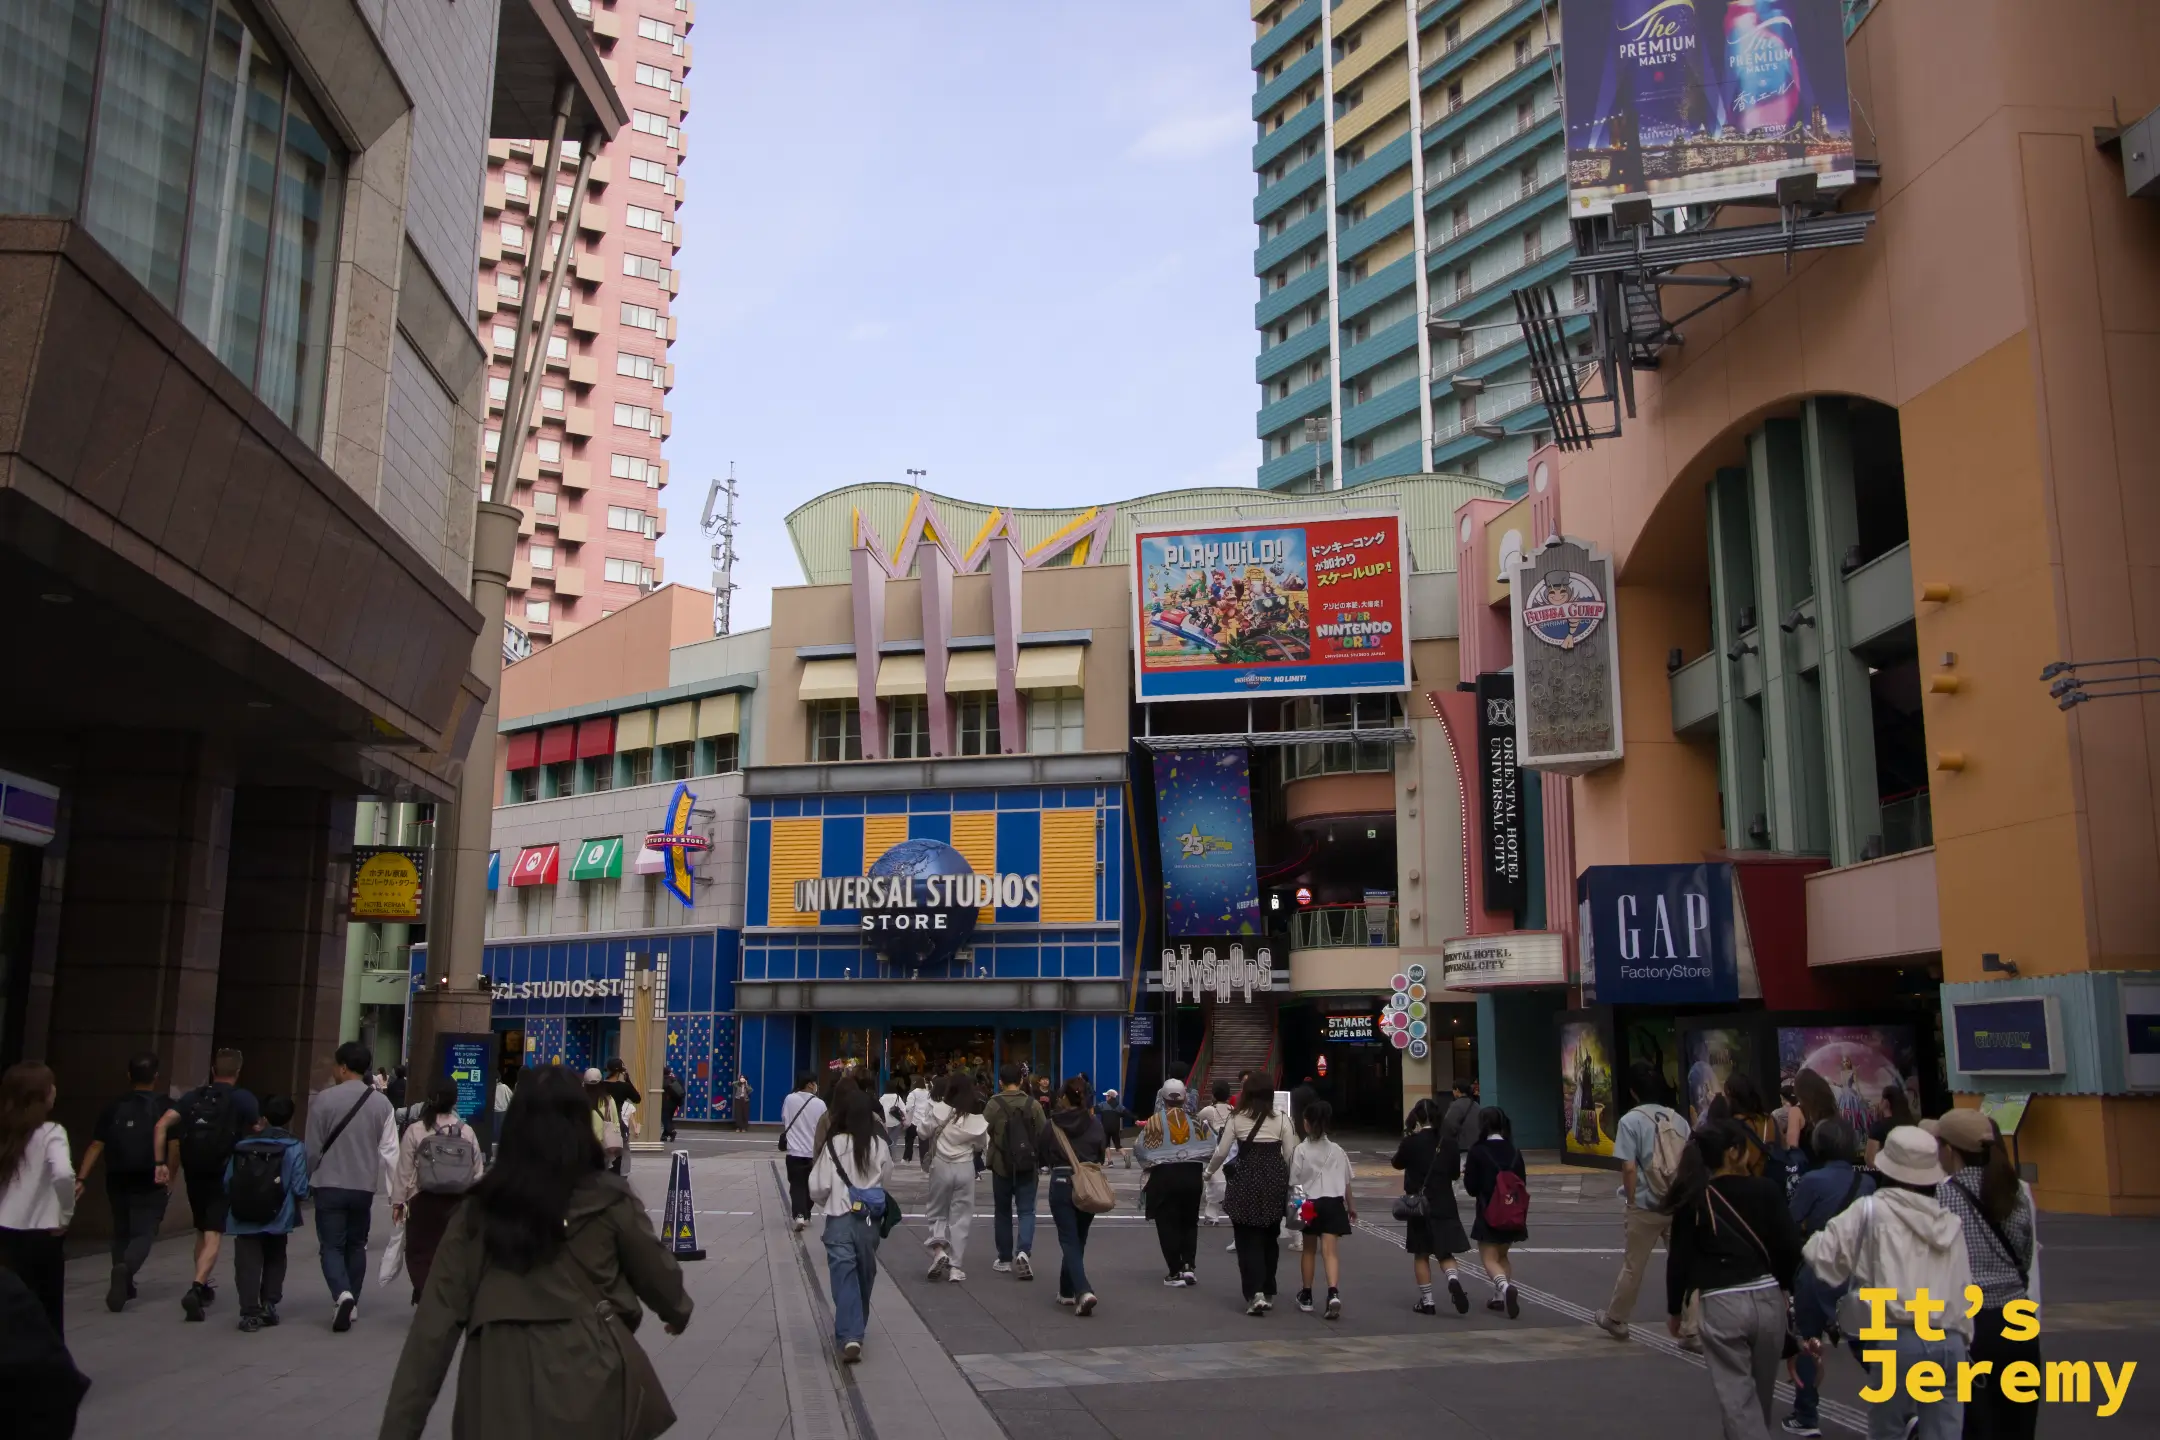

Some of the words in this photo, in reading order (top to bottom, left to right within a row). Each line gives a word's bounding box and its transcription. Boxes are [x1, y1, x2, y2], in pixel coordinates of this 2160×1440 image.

[1619, 35, 1695, 59] PREMIUM
[1639, 52, 1677, 67] MALT'S
[1729, 48, 1793, 68] PREMIUM
[1746, 62, 1778, 74] MALT'S
[1312, 531, 1386, 558] ドンキーコング
[1164, 542, 1219, 569] PLAY
[1315, 553, 1356, 571] が加わり
[1525, 607, 1566, 625] BUBBA
[1568, 603, 1604, 617] GUMP
[1316, 621, 1392, 638] NINTENDO
[1328, 635, 1380, 649] WORLD
[1490, 737, 1504, 831] UNIVERSAL
[1503, 737, 1516, 823] ORIENTAL
[1494, 834, 1506, 876] CITY
[1506, 827, 1519, 884] HOTEL
[794, 876, 917, 912] UNIVERSAL
[926, 873, 1040, 908] STUDIOS
[861, 914, 948, 930] STORE
[1617, 893, 1710, 960] GAP
[1474, 949, 1511, 959] HOTEL
[1479, 959, 1505, 970] CITY
[521, 979, 595, 999] STUDIOS
[1328, 1028, 1348, 1037] CAFÉ
